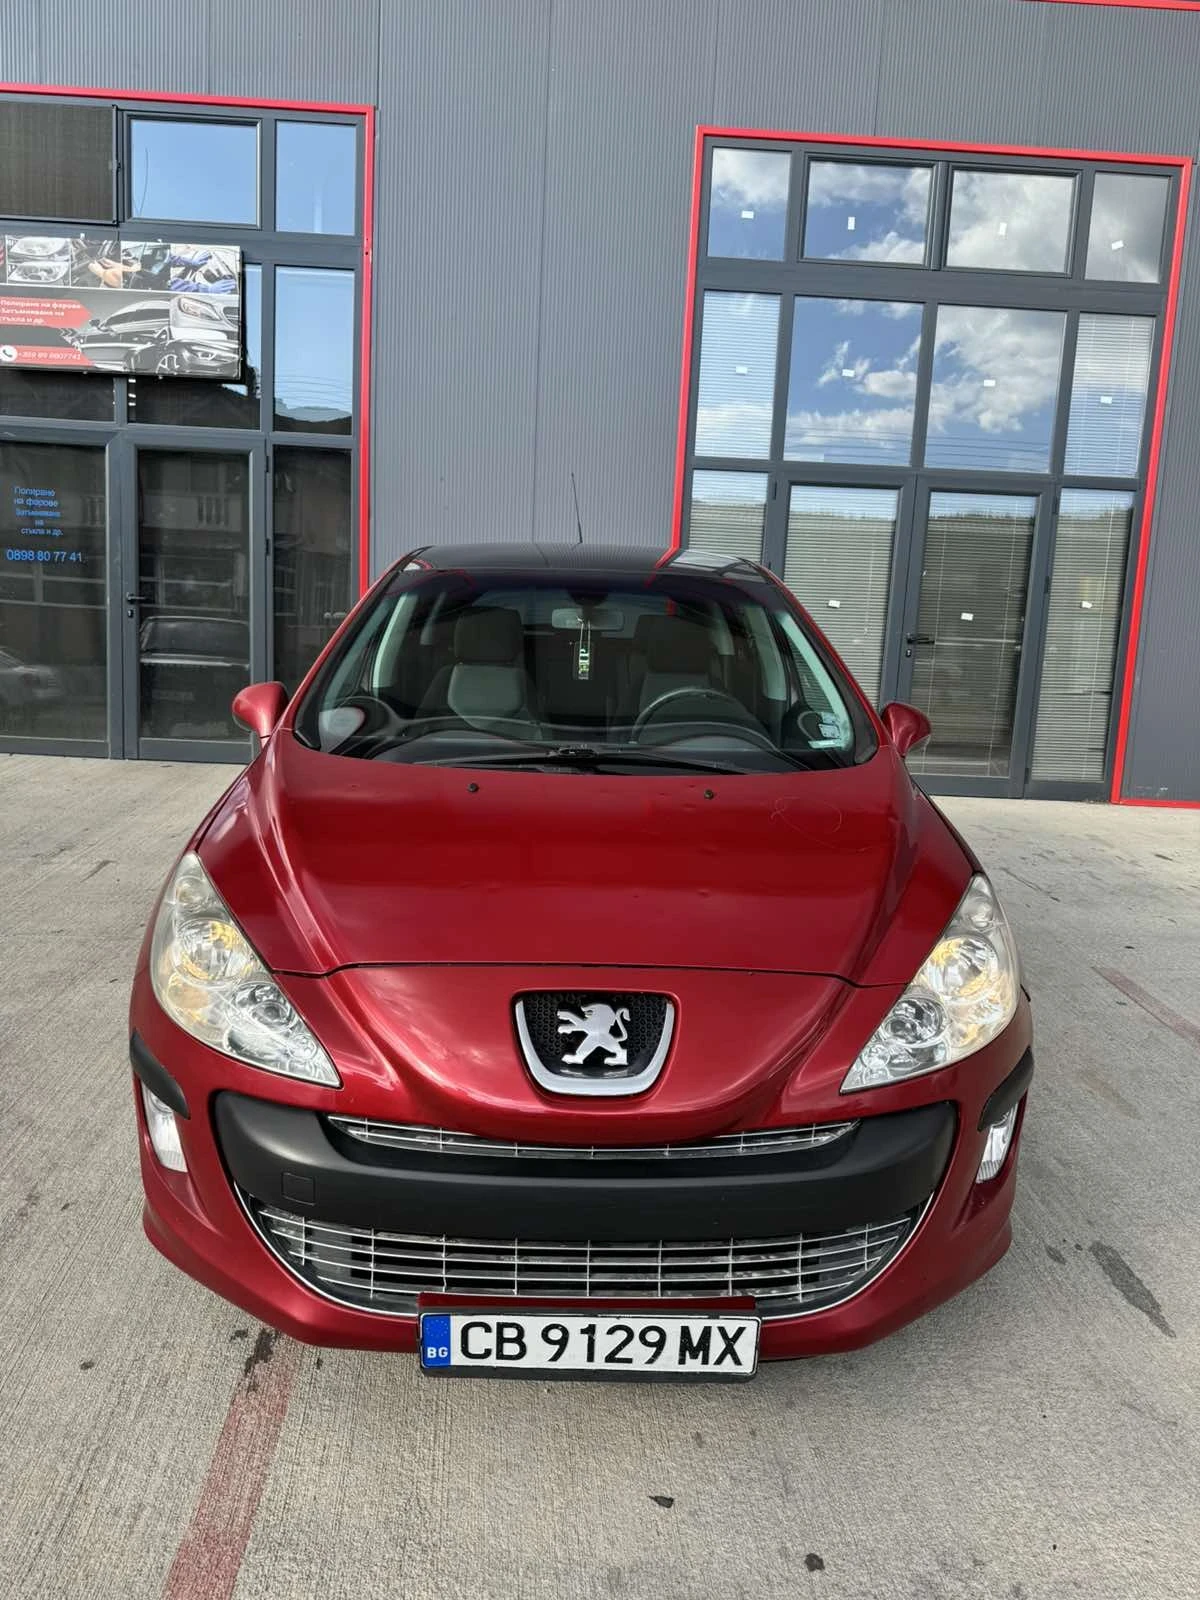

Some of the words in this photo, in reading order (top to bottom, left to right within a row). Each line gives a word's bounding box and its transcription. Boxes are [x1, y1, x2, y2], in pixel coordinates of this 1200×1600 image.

[7, 549, 35, 561] 0898
[37, 550, 50, 561] 80
[53, 551, 67, 562] 77
[69, 551, 82, 562] 41
[460, 1321, 527, 1361] CB
[541, 1323, 667, 1365] 9129
[678, 1325, 747, 1366] MX
[427, 1346, 448, 1358] BG
